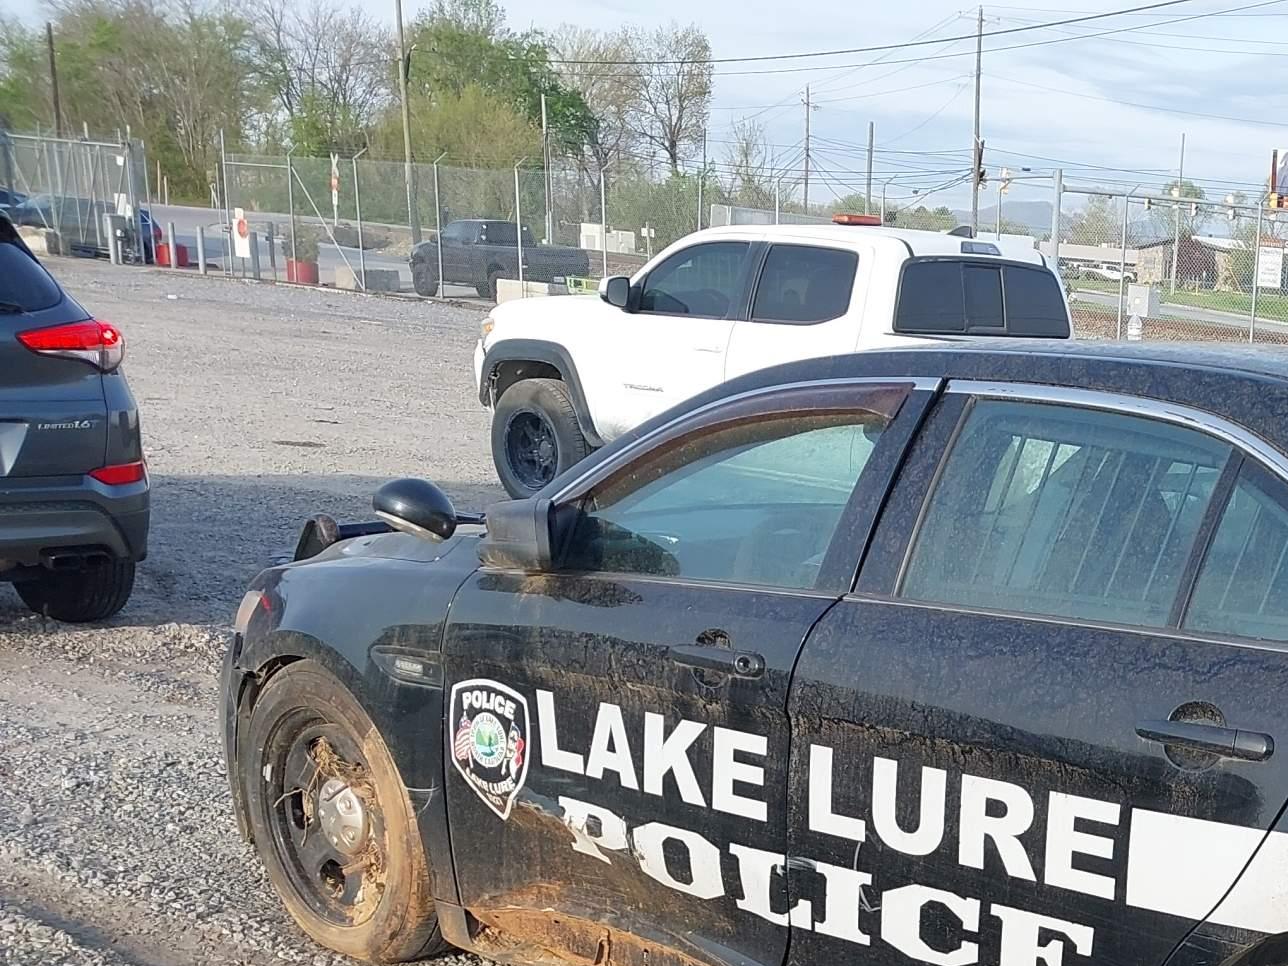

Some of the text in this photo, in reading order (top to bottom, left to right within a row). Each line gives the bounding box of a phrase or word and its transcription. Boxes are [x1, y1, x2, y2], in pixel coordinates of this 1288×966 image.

[462, 690, 516, 721] POLICE
[488, 776, 515, 796] LURE
[535, 688, 1122, 901] LAKE LURE
